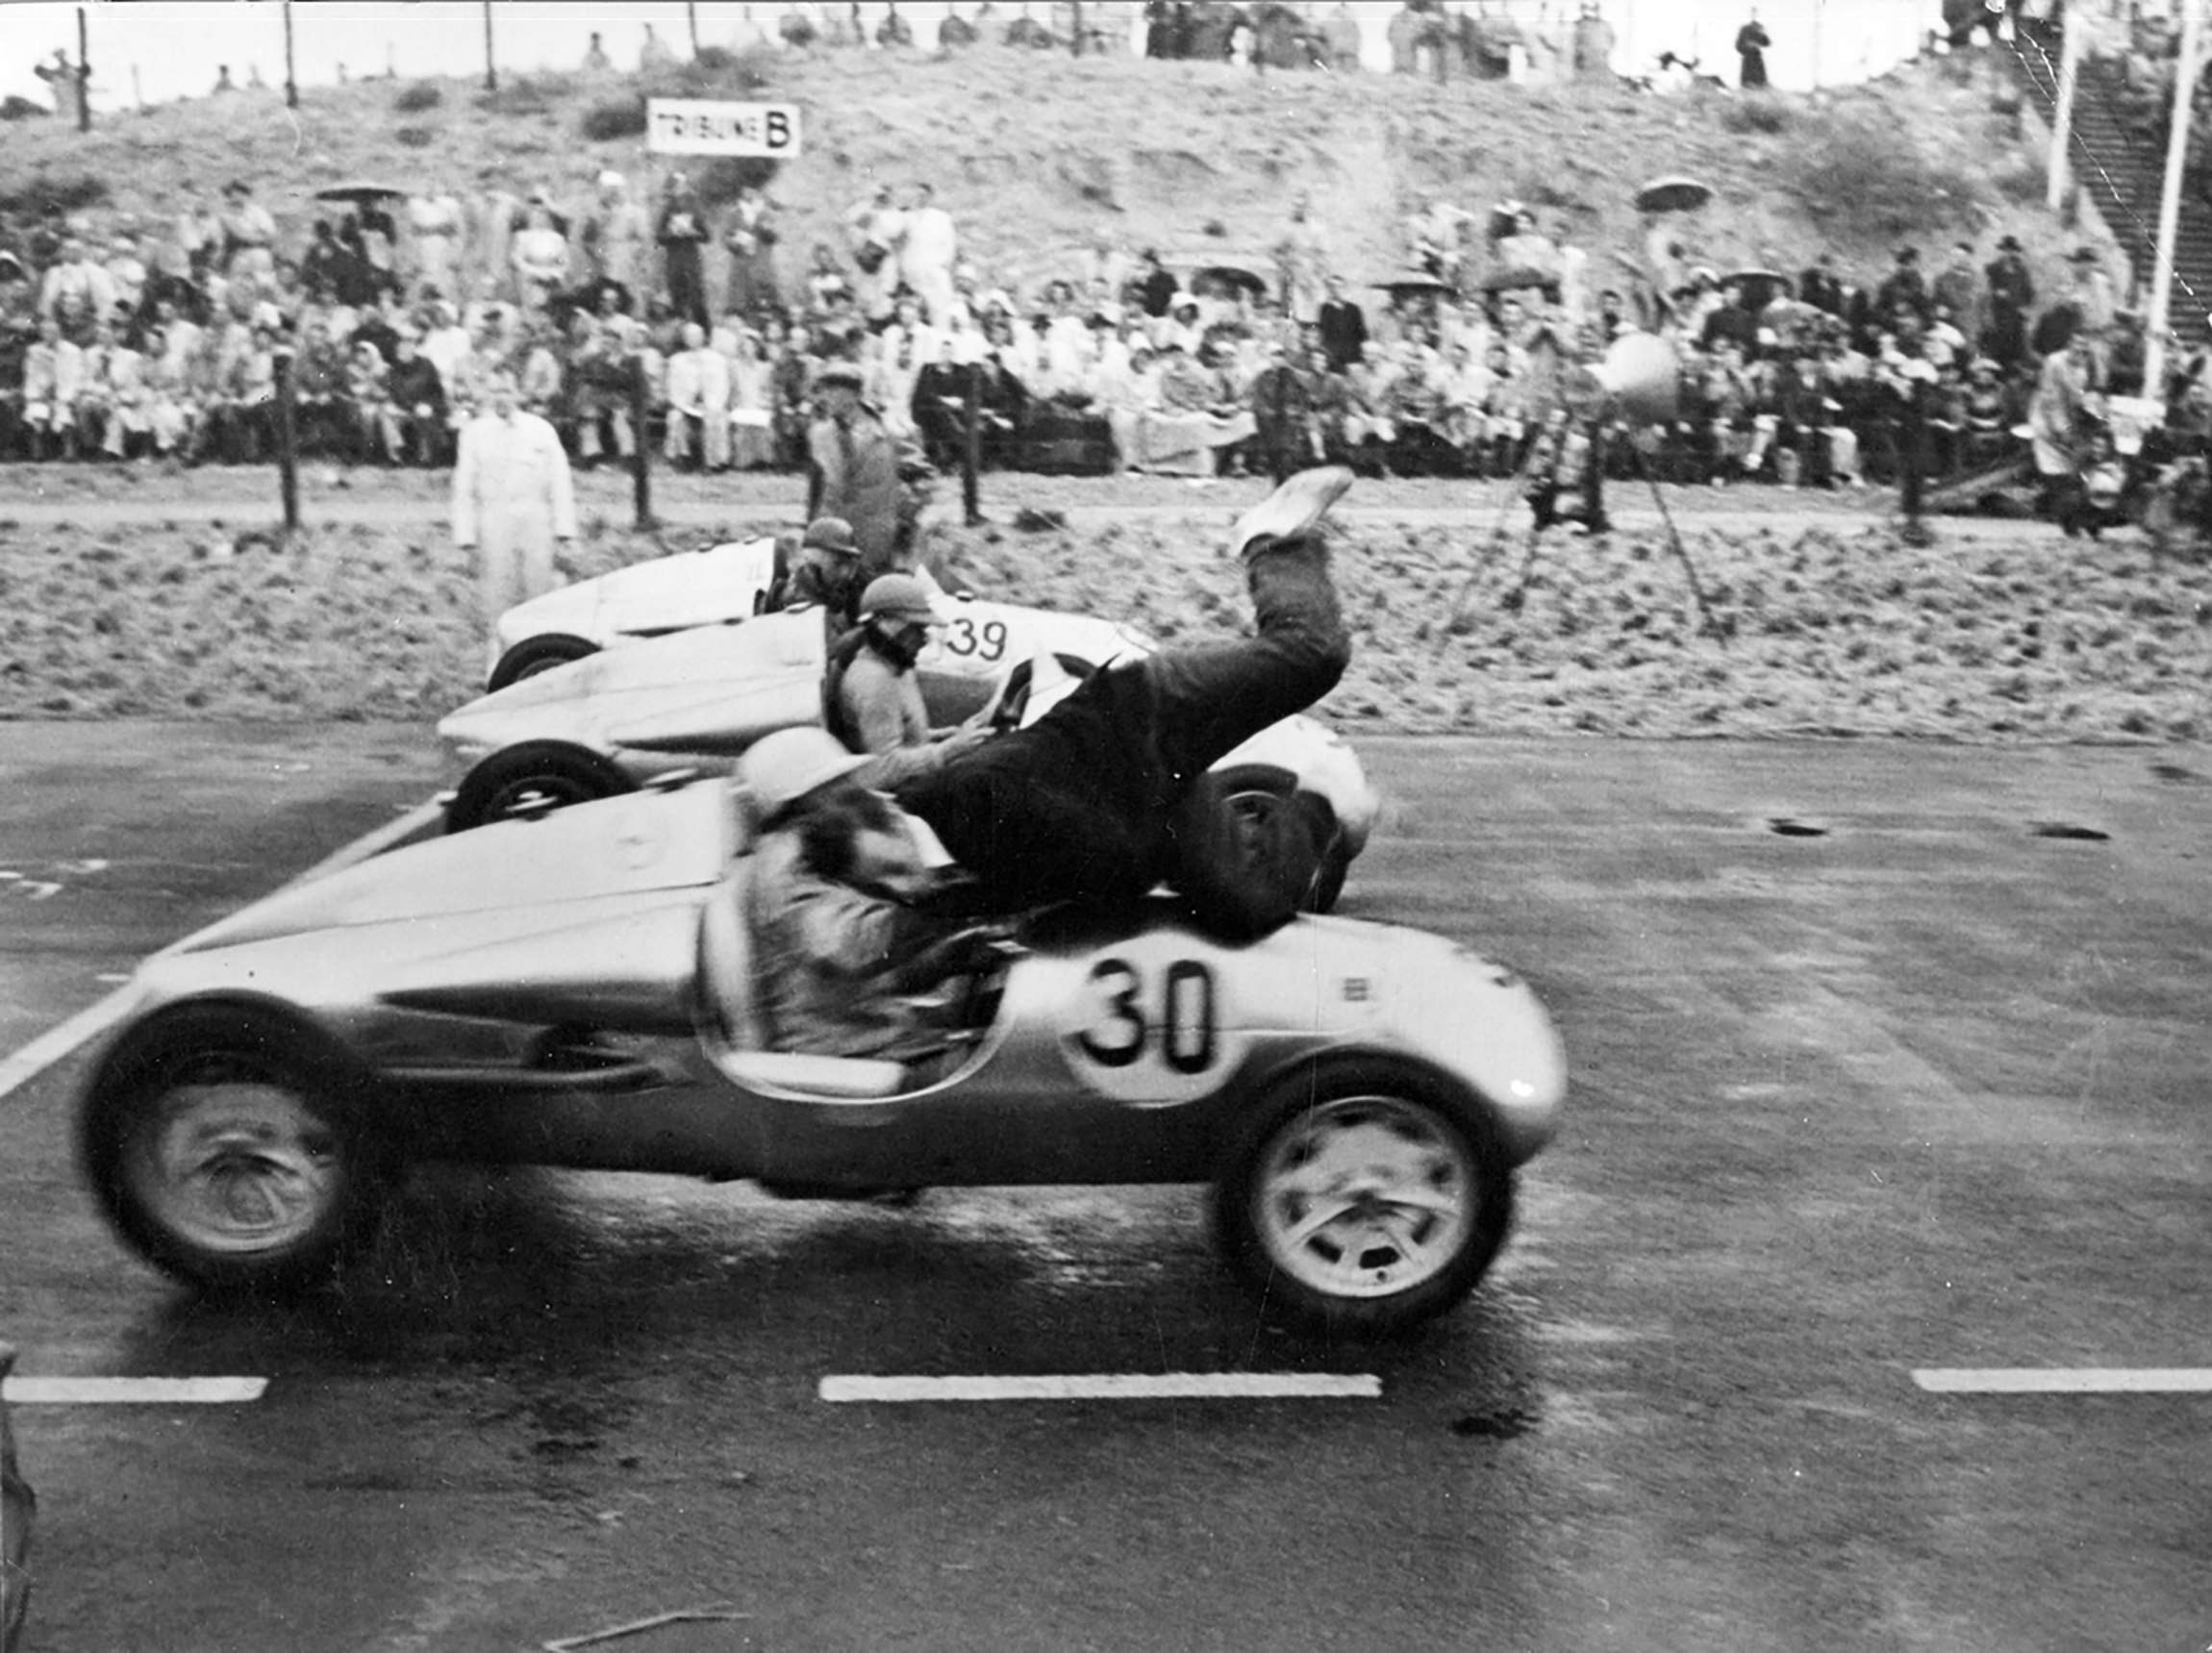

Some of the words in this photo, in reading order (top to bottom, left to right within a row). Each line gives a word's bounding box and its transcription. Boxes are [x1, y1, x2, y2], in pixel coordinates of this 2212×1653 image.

[766, 110, 791, 149] B
[945, 617, 1007, 663] 39
[1078, 957, 1216, 1074] 30
